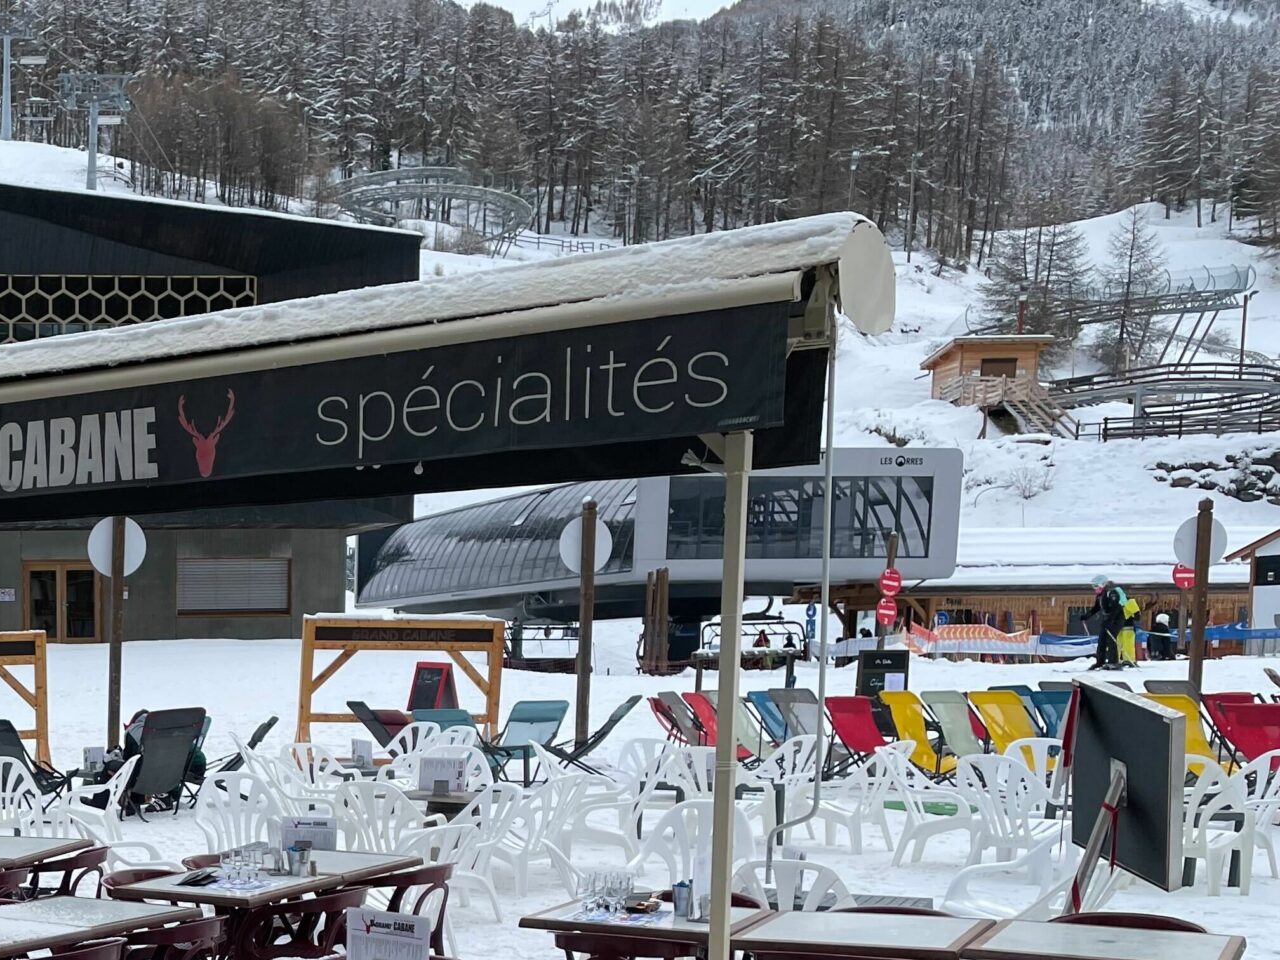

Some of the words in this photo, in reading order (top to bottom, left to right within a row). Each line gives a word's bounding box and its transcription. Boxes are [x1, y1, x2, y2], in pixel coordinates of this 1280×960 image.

[315, 336, 730, 459] spécialités
[880, 456, 893, 466] LES
[352, 630, 399, 640] GRAND
[402, 630, 456, 641] CABANE
[394, 921, 415, 933] CABANE
